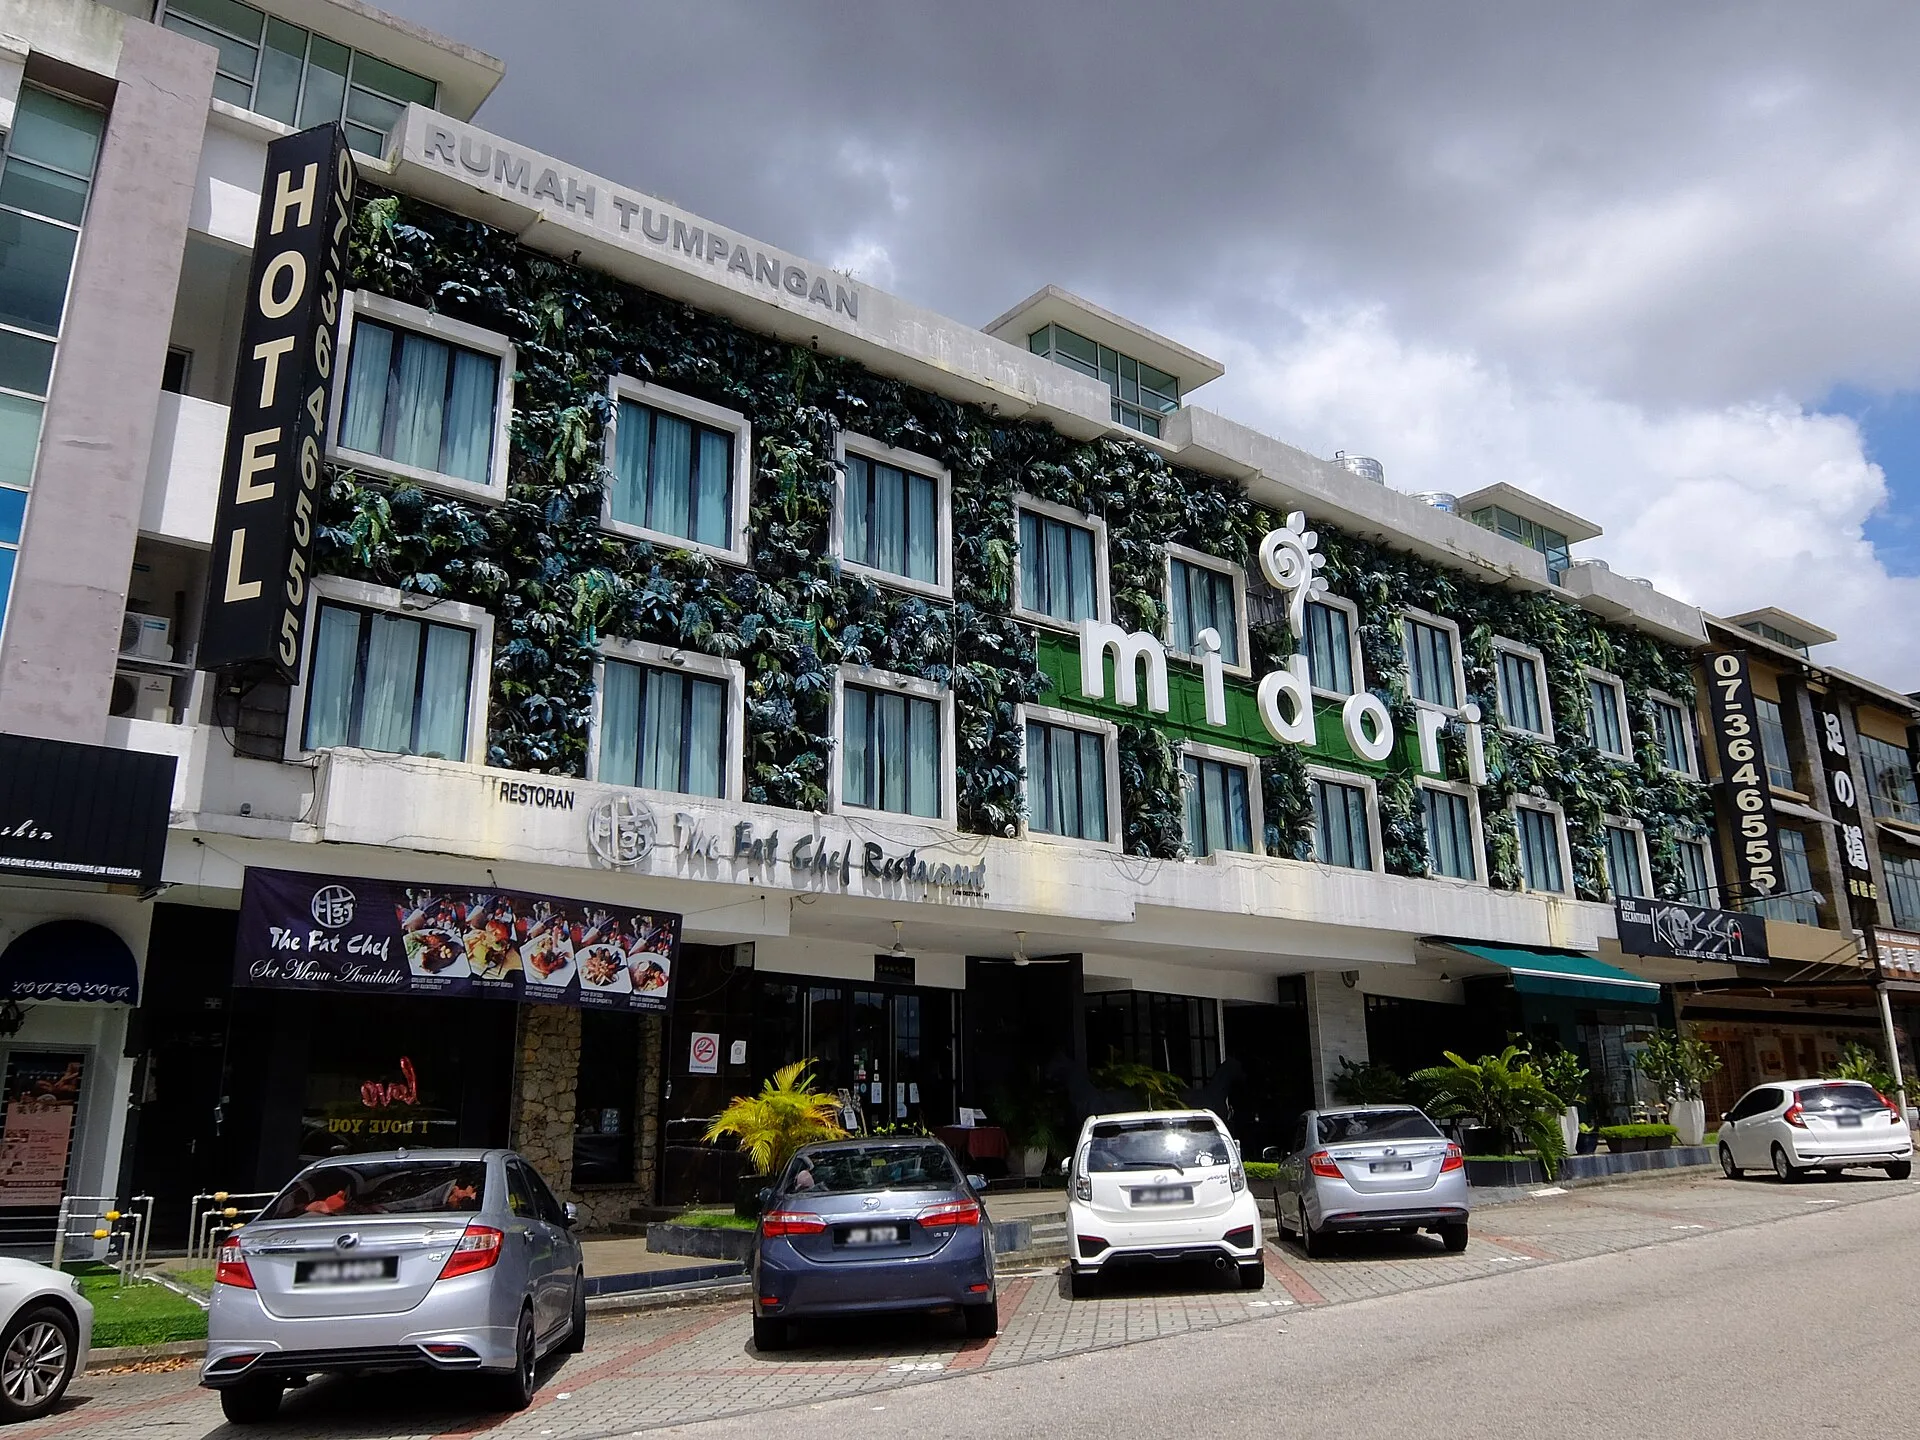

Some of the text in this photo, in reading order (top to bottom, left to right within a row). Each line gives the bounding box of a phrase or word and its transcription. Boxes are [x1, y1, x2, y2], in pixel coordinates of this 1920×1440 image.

[424, 123, 859, 320] RUMAH TUMPANGAN
[224, 162, 318, 603] HOTEL
[279, 148, 352, 667] 07-3646555
[1079, 617, 1487, 786] midori
[1714, 655, 1777, 894] 07-3646555
[500, 781, 574, 810] RESTORAN
[26, 860, 53, 869] GLOBAL
[54, 862, 94, 873] ENTERPRISE
[1620, 900, 1636, 912] PUSAT
[1621, 911, 1652, 925] KECANTIKAN
[269, 926, 301, 951] The
[347, 934, 391, 962] Chef
[1675, 949, 1705, 959] EXCLUSIVE
[1706, 951, 1728, 961] CENTRE
[250, 959, 280, 981] Set
[281, 958, 332, 982] Menu
[334, 962, 404, 985] Available
